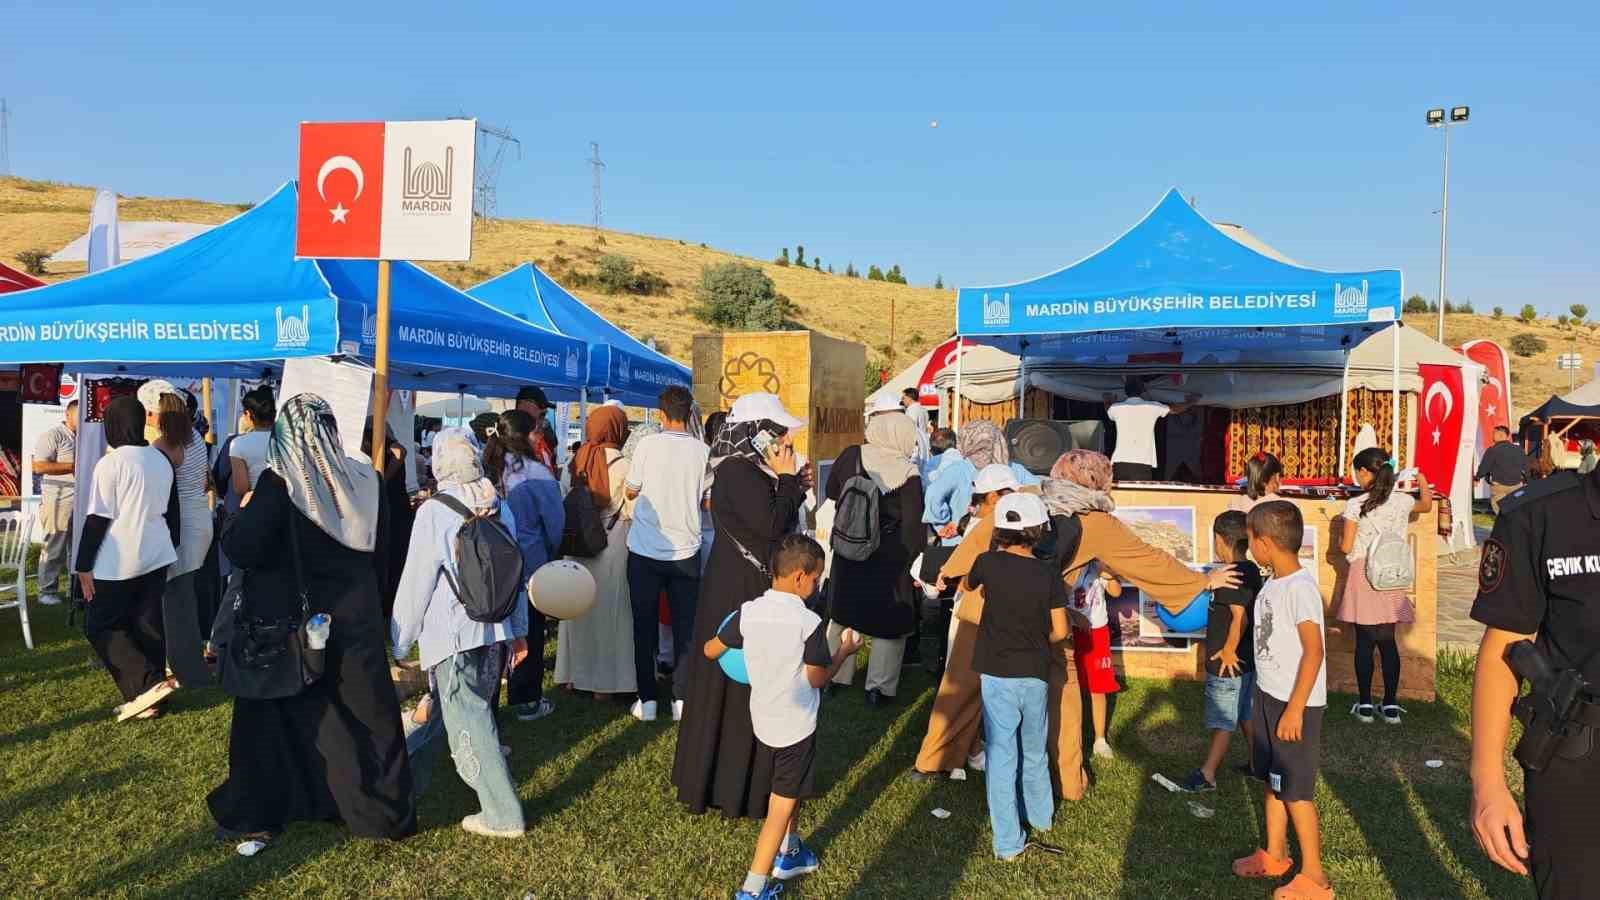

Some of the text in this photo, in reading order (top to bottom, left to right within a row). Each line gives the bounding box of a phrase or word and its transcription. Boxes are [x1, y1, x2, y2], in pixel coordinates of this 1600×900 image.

[1026, 290, 1317, 317] MARDİN BÜYÜKŞEHİR BELEDİYESİ
[40, 319, 150, 344] BÜYÜKŞEHİR
[154, 319, 260, 341] BELEDİYESİ
[399, 325, 561, 368] MARDİN BÜYÜKŞEHİR BELEDİYESİ
